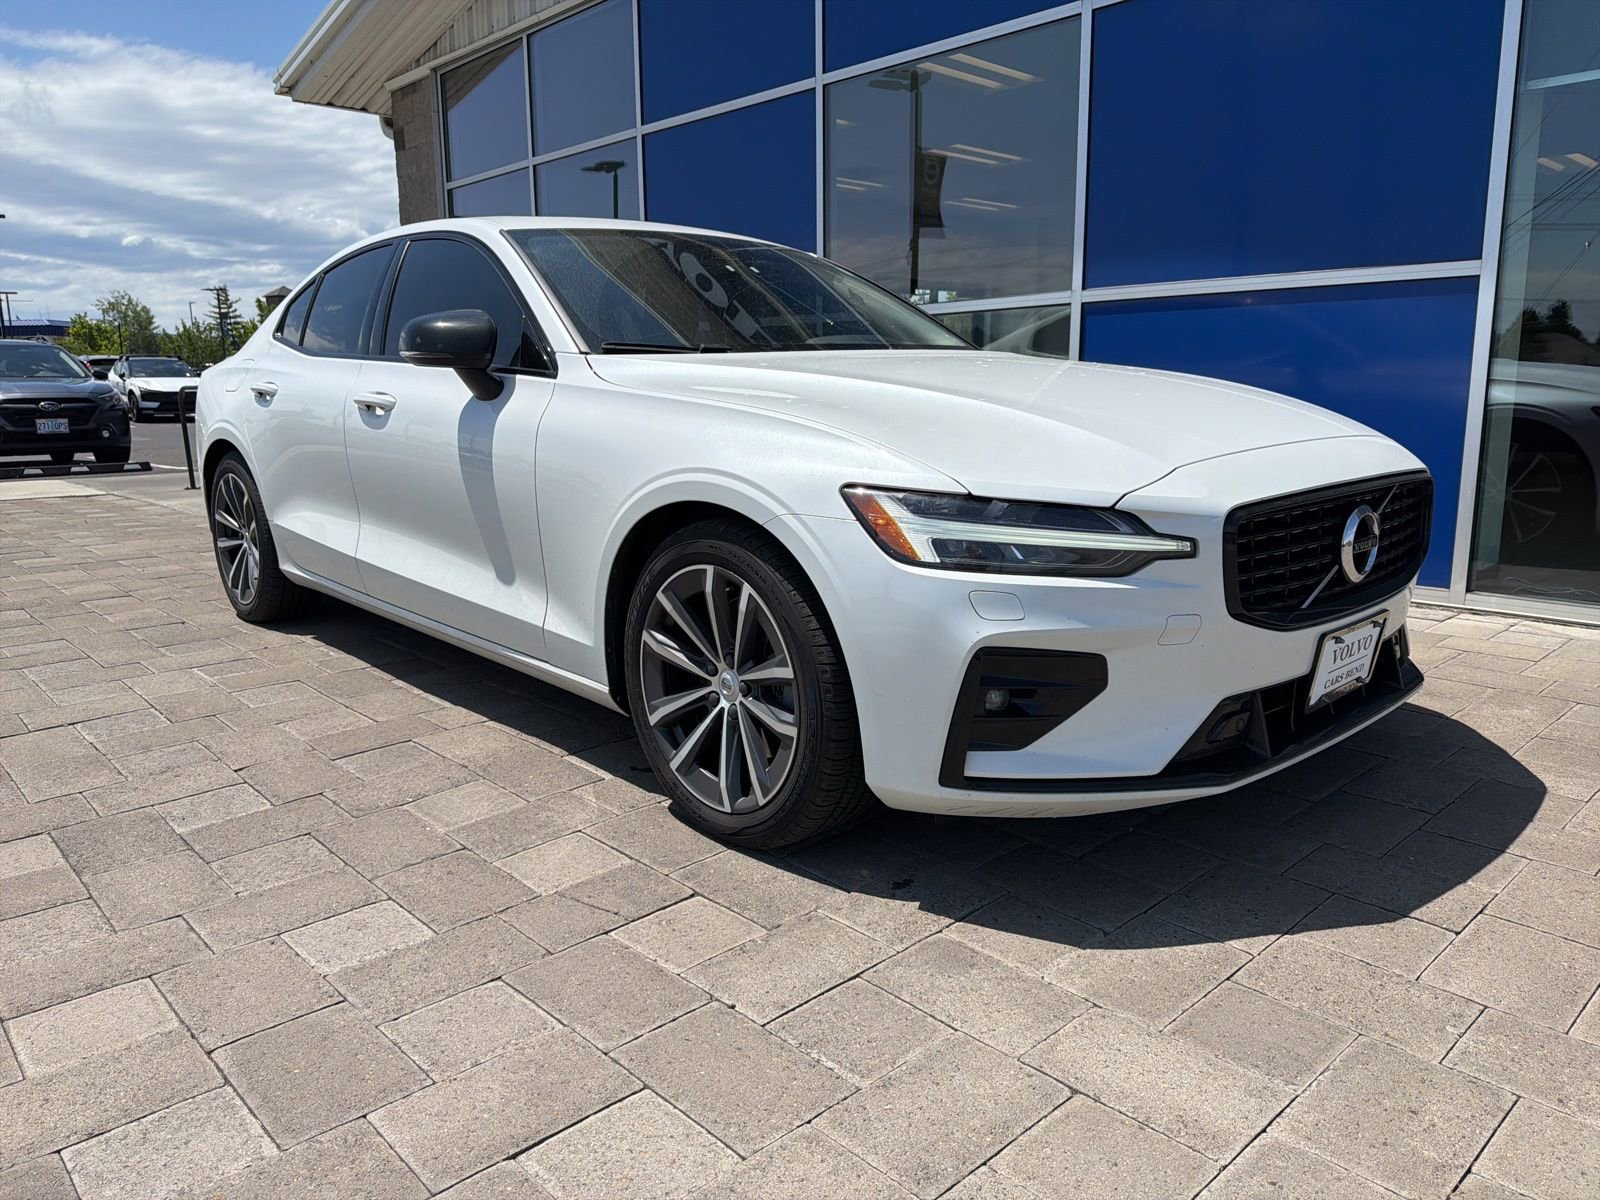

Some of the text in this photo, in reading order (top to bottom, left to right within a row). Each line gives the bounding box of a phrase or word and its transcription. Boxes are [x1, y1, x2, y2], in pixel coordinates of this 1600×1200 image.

[1355, 538, 1377, 551] VOLVO
[1333, 634, 1373, 664] VOLVO
[1324, 663, 1365, 689] CARS BEND
